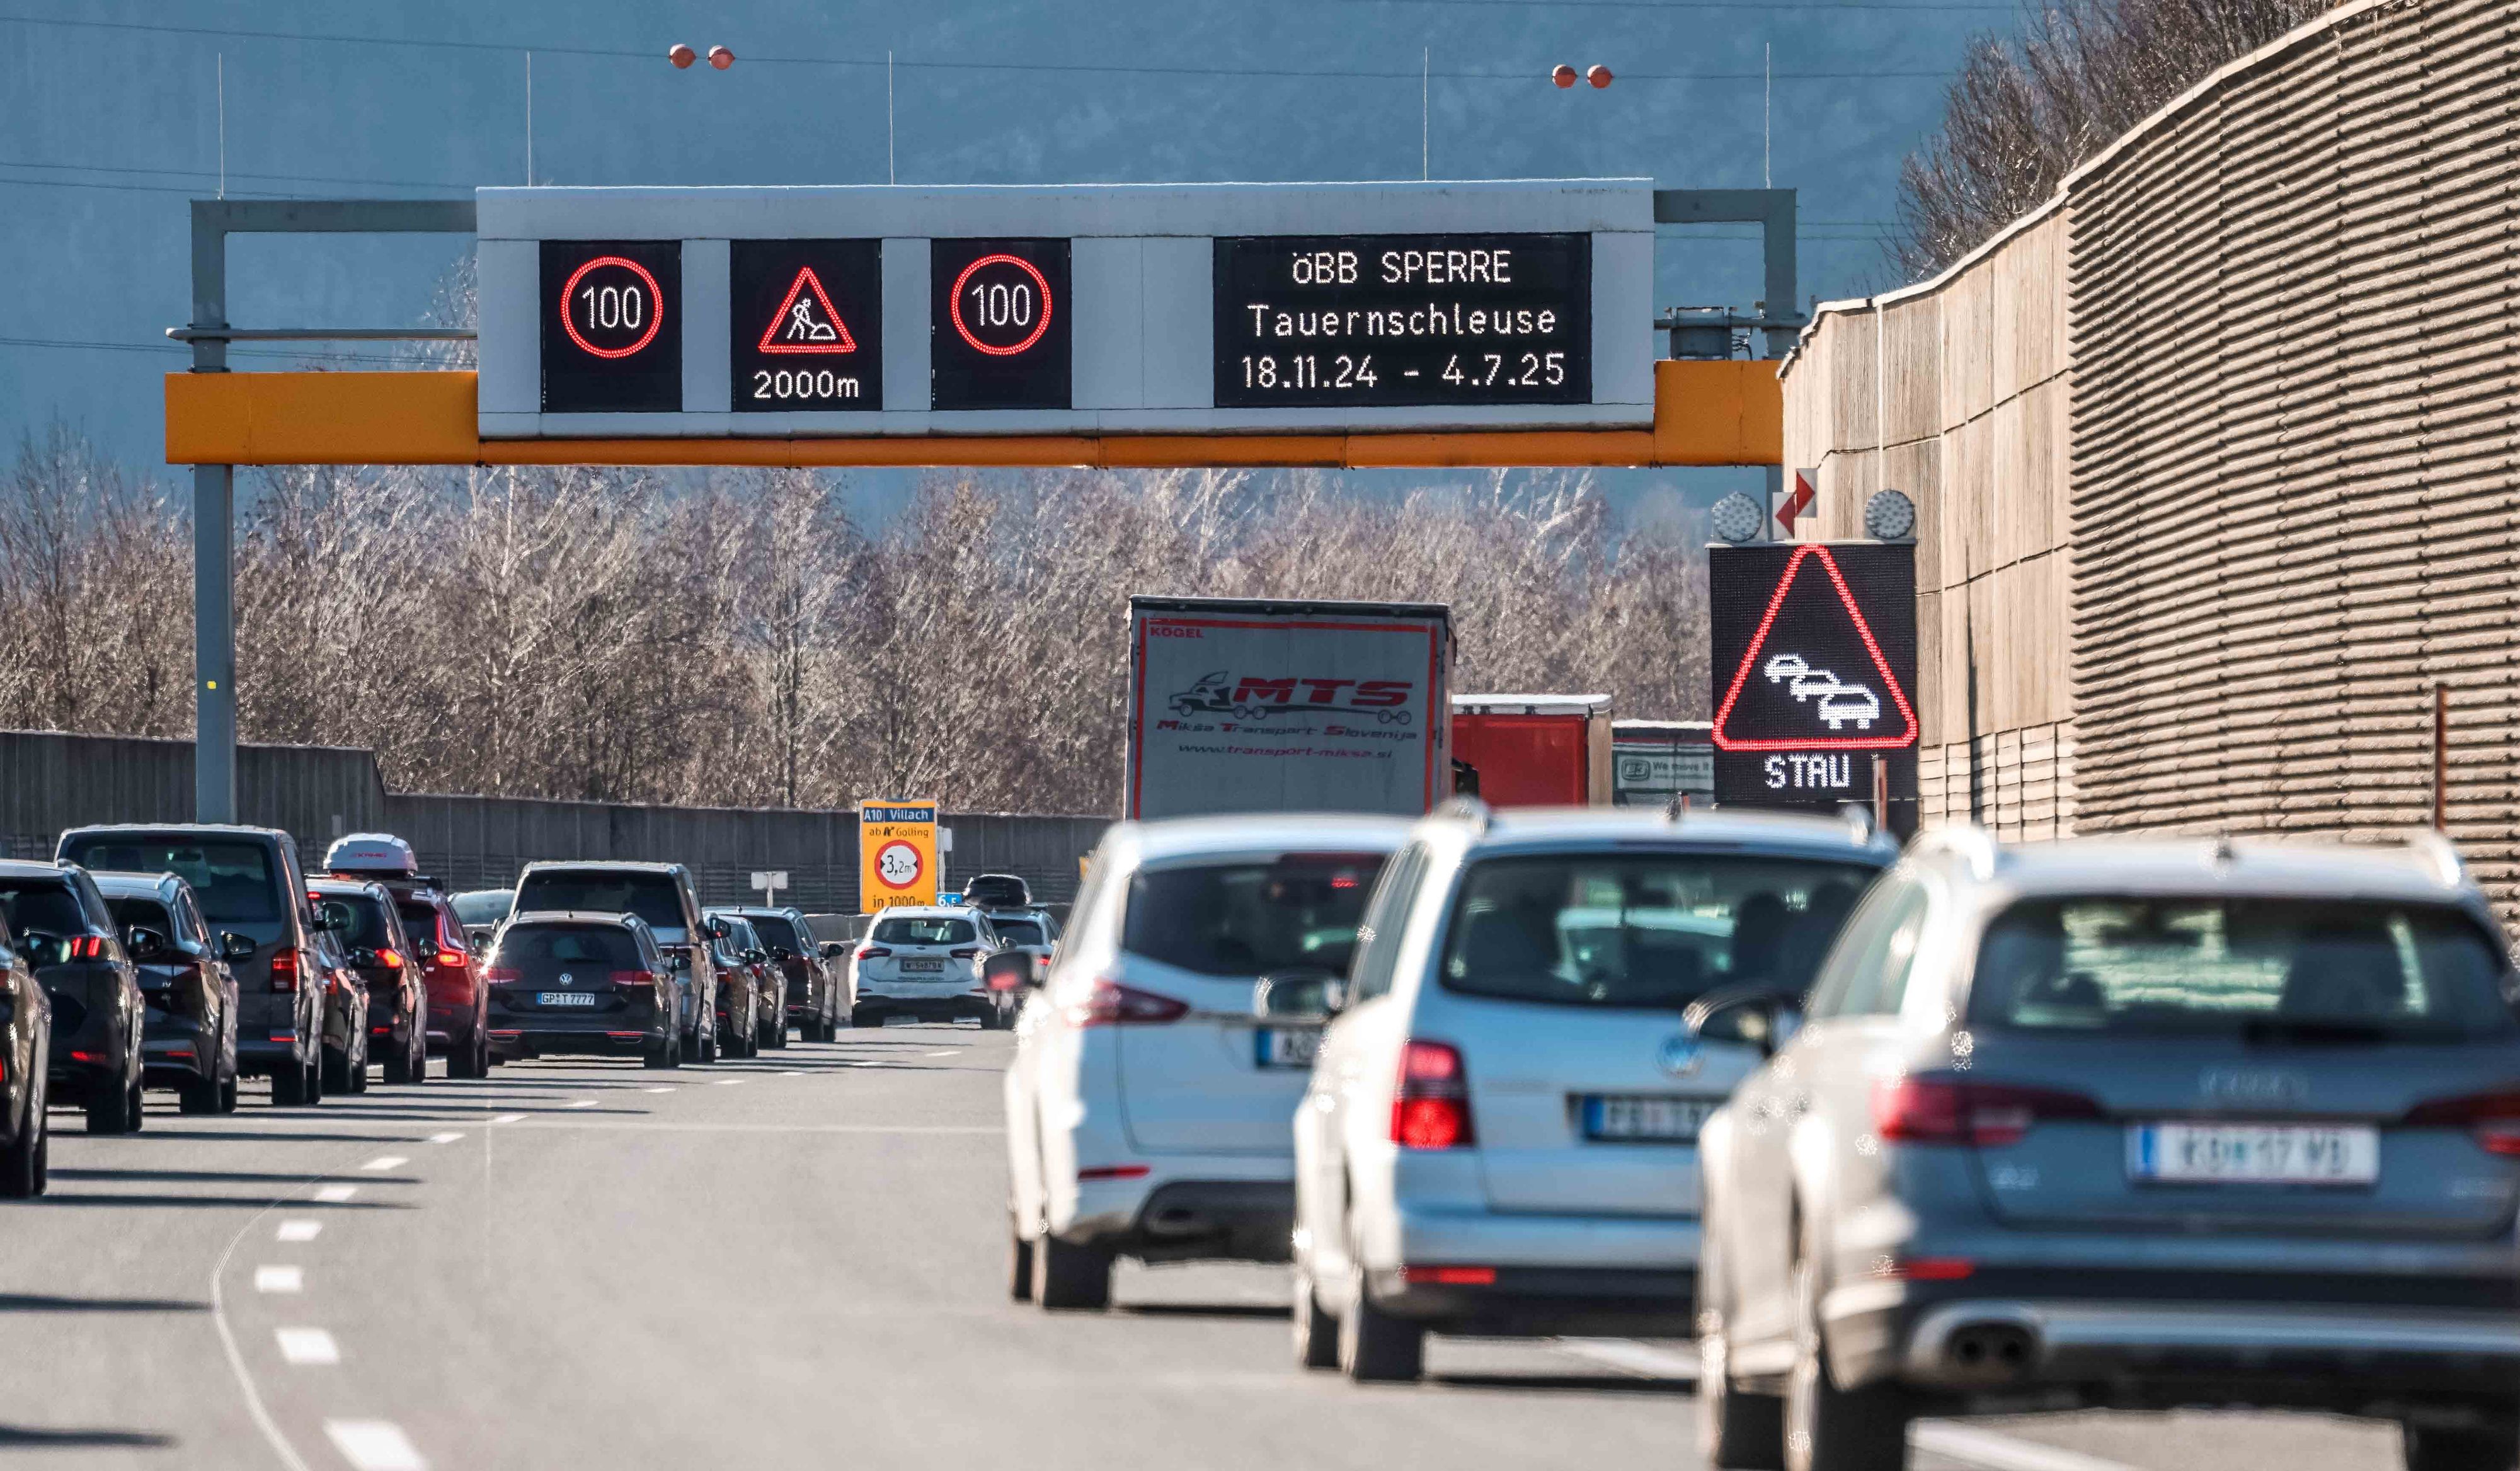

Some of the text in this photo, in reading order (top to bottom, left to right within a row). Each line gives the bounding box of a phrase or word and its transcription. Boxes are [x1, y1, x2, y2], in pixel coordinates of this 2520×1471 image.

[1382, 249, 1511, 283] SPERRE
[582, 286, 641, 329] 100
[972, 283, 1031, 326] 100
[1247, 302, 1556, 336] Tauernschleuse
[754, 370, 859, 399] 2000m
[1242, 353, 1378, 389] 18.11.24
[1442, 352, 1564, 387] 4.7.25
[1233, 676, 1412, 706] MTS
[1221, 723, 1317, 737] Transport
[1324, 725, 1417, 741] Slovenija
[1765, 753, 1850, 789] STAU
[864, 808, 929, 821] A10 Villach
[869, 827, 929, 838] ab Golling
[873, 895, 884, 908] in
[542, 994, 594, 1004] GP T 7777
